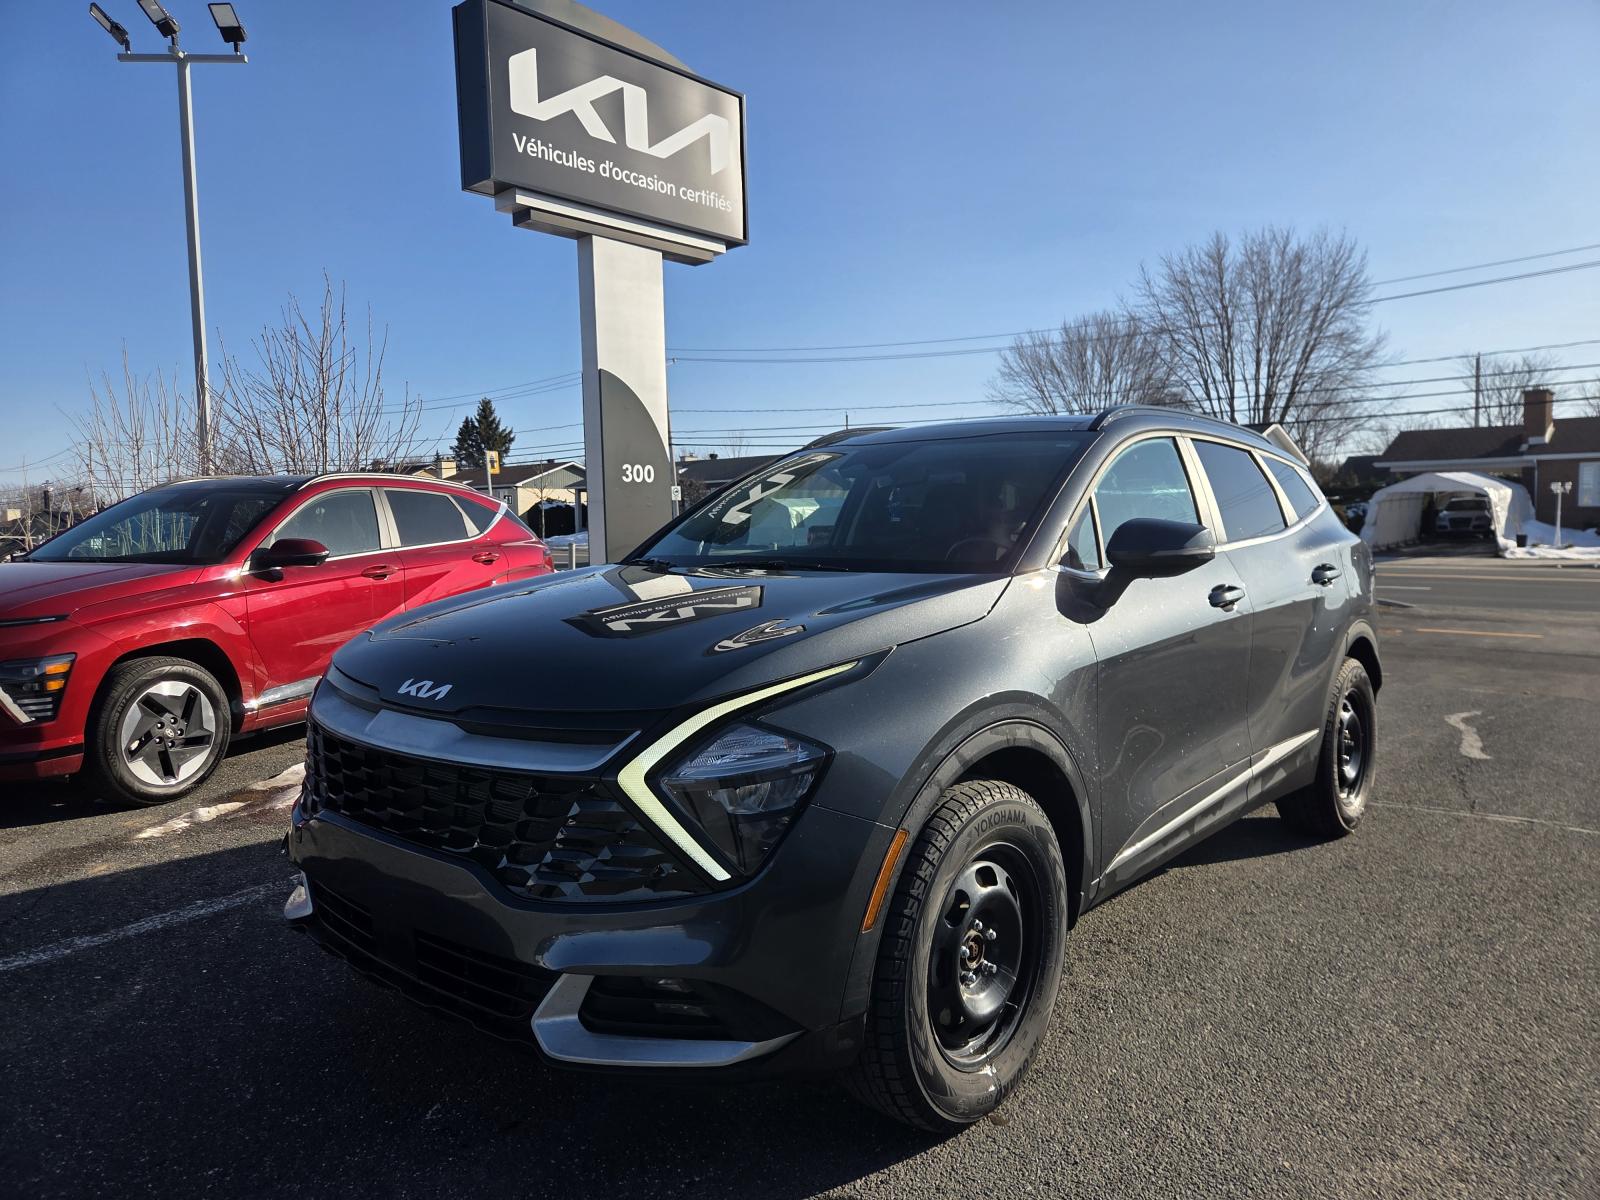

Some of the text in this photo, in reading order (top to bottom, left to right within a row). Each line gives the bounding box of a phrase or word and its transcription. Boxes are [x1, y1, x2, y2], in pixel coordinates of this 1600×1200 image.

[508, 47, 729, 175] KIA
[512, 132, 732, 213] Véhicules d'occasion certifiés
[621, 463, 655, 484] 300
[397, 678, 453, 701] KIA
[974, 810, 1028, 838] YOKOHAMA
